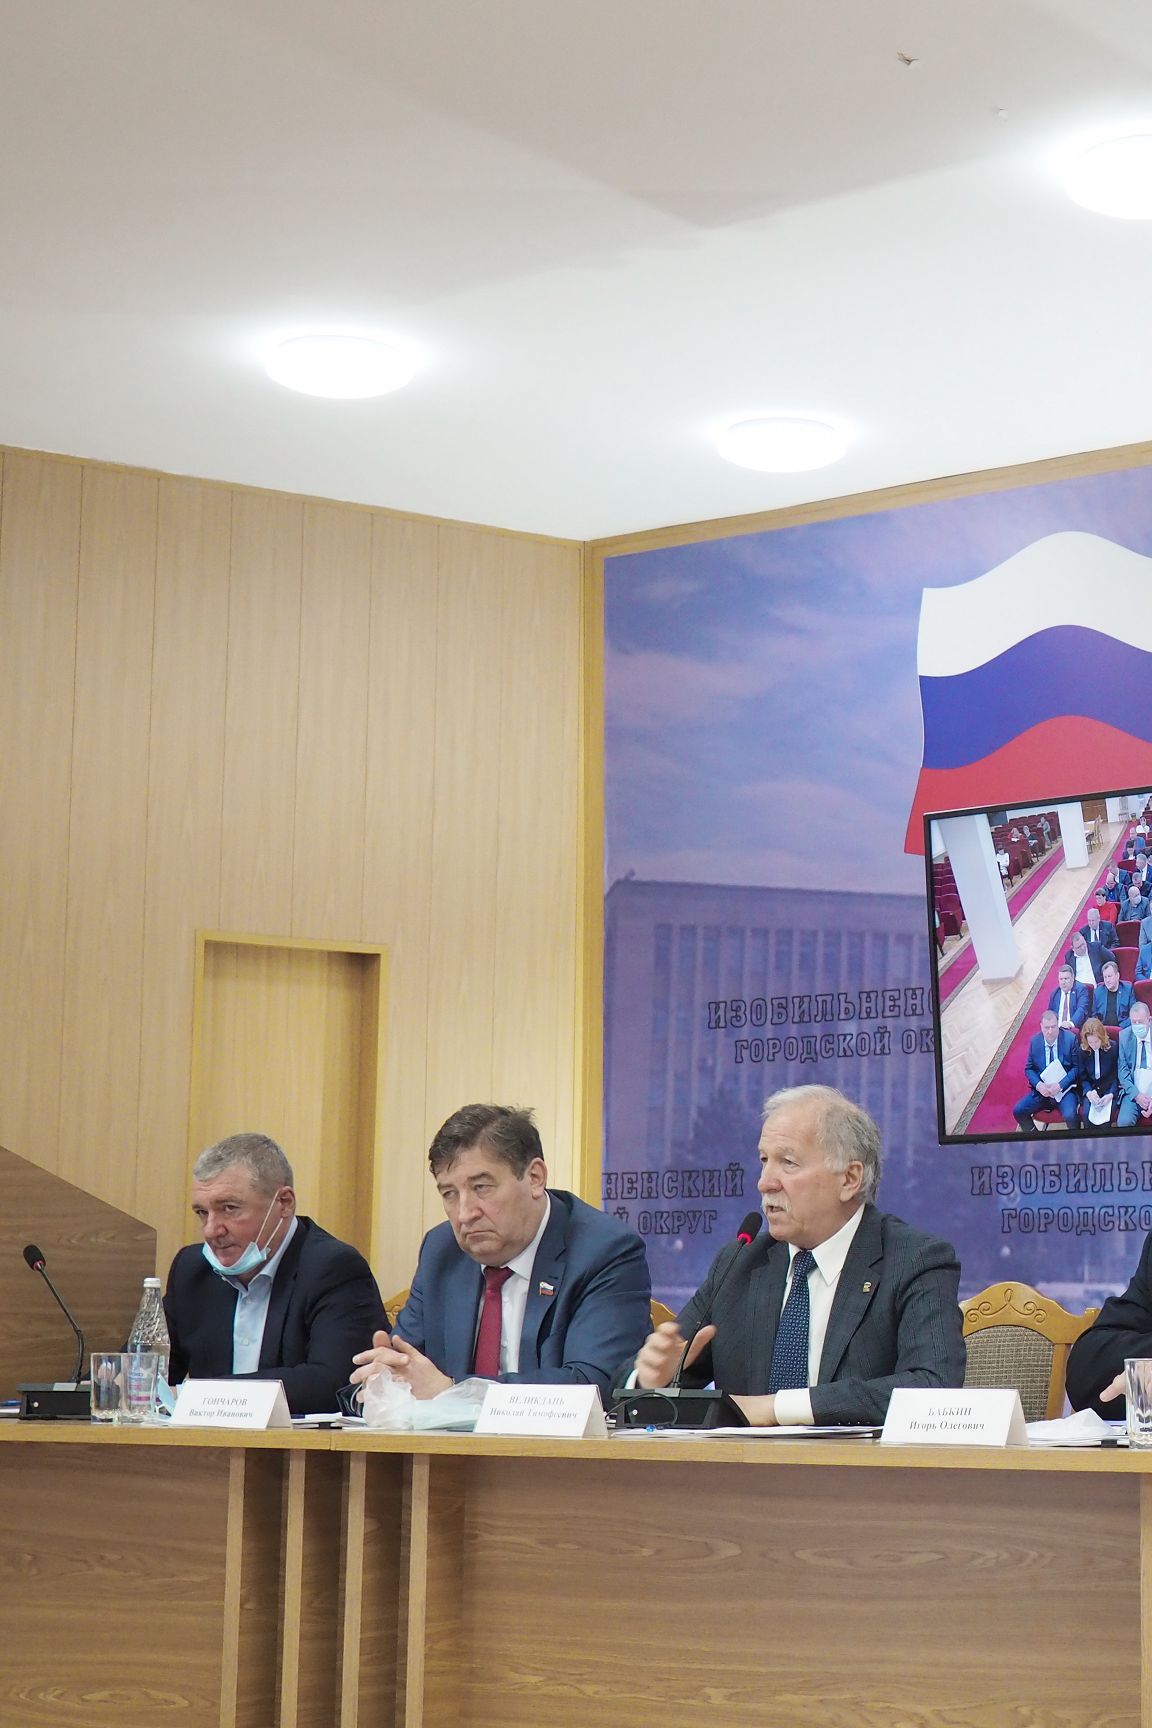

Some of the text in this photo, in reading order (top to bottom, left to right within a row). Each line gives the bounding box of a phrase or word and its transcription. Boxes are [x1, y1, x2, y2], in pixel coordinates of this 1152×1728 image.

[708, 987, 933, 1029] ИЗОБИЛЬНЕН
[734, 1026, 891, 1063] ГОРОДСКОЙ
[638, 1210, 718, 1235] ОКРУГ
[202, 1397, 248, 1406] ГОНЧАРОВ
[188, 1408, 253, 1419] Виктор Иванович
[490, 1407, 524, 1417] Николай
[909, 1420, 985, 1432] Игорь Олегович
